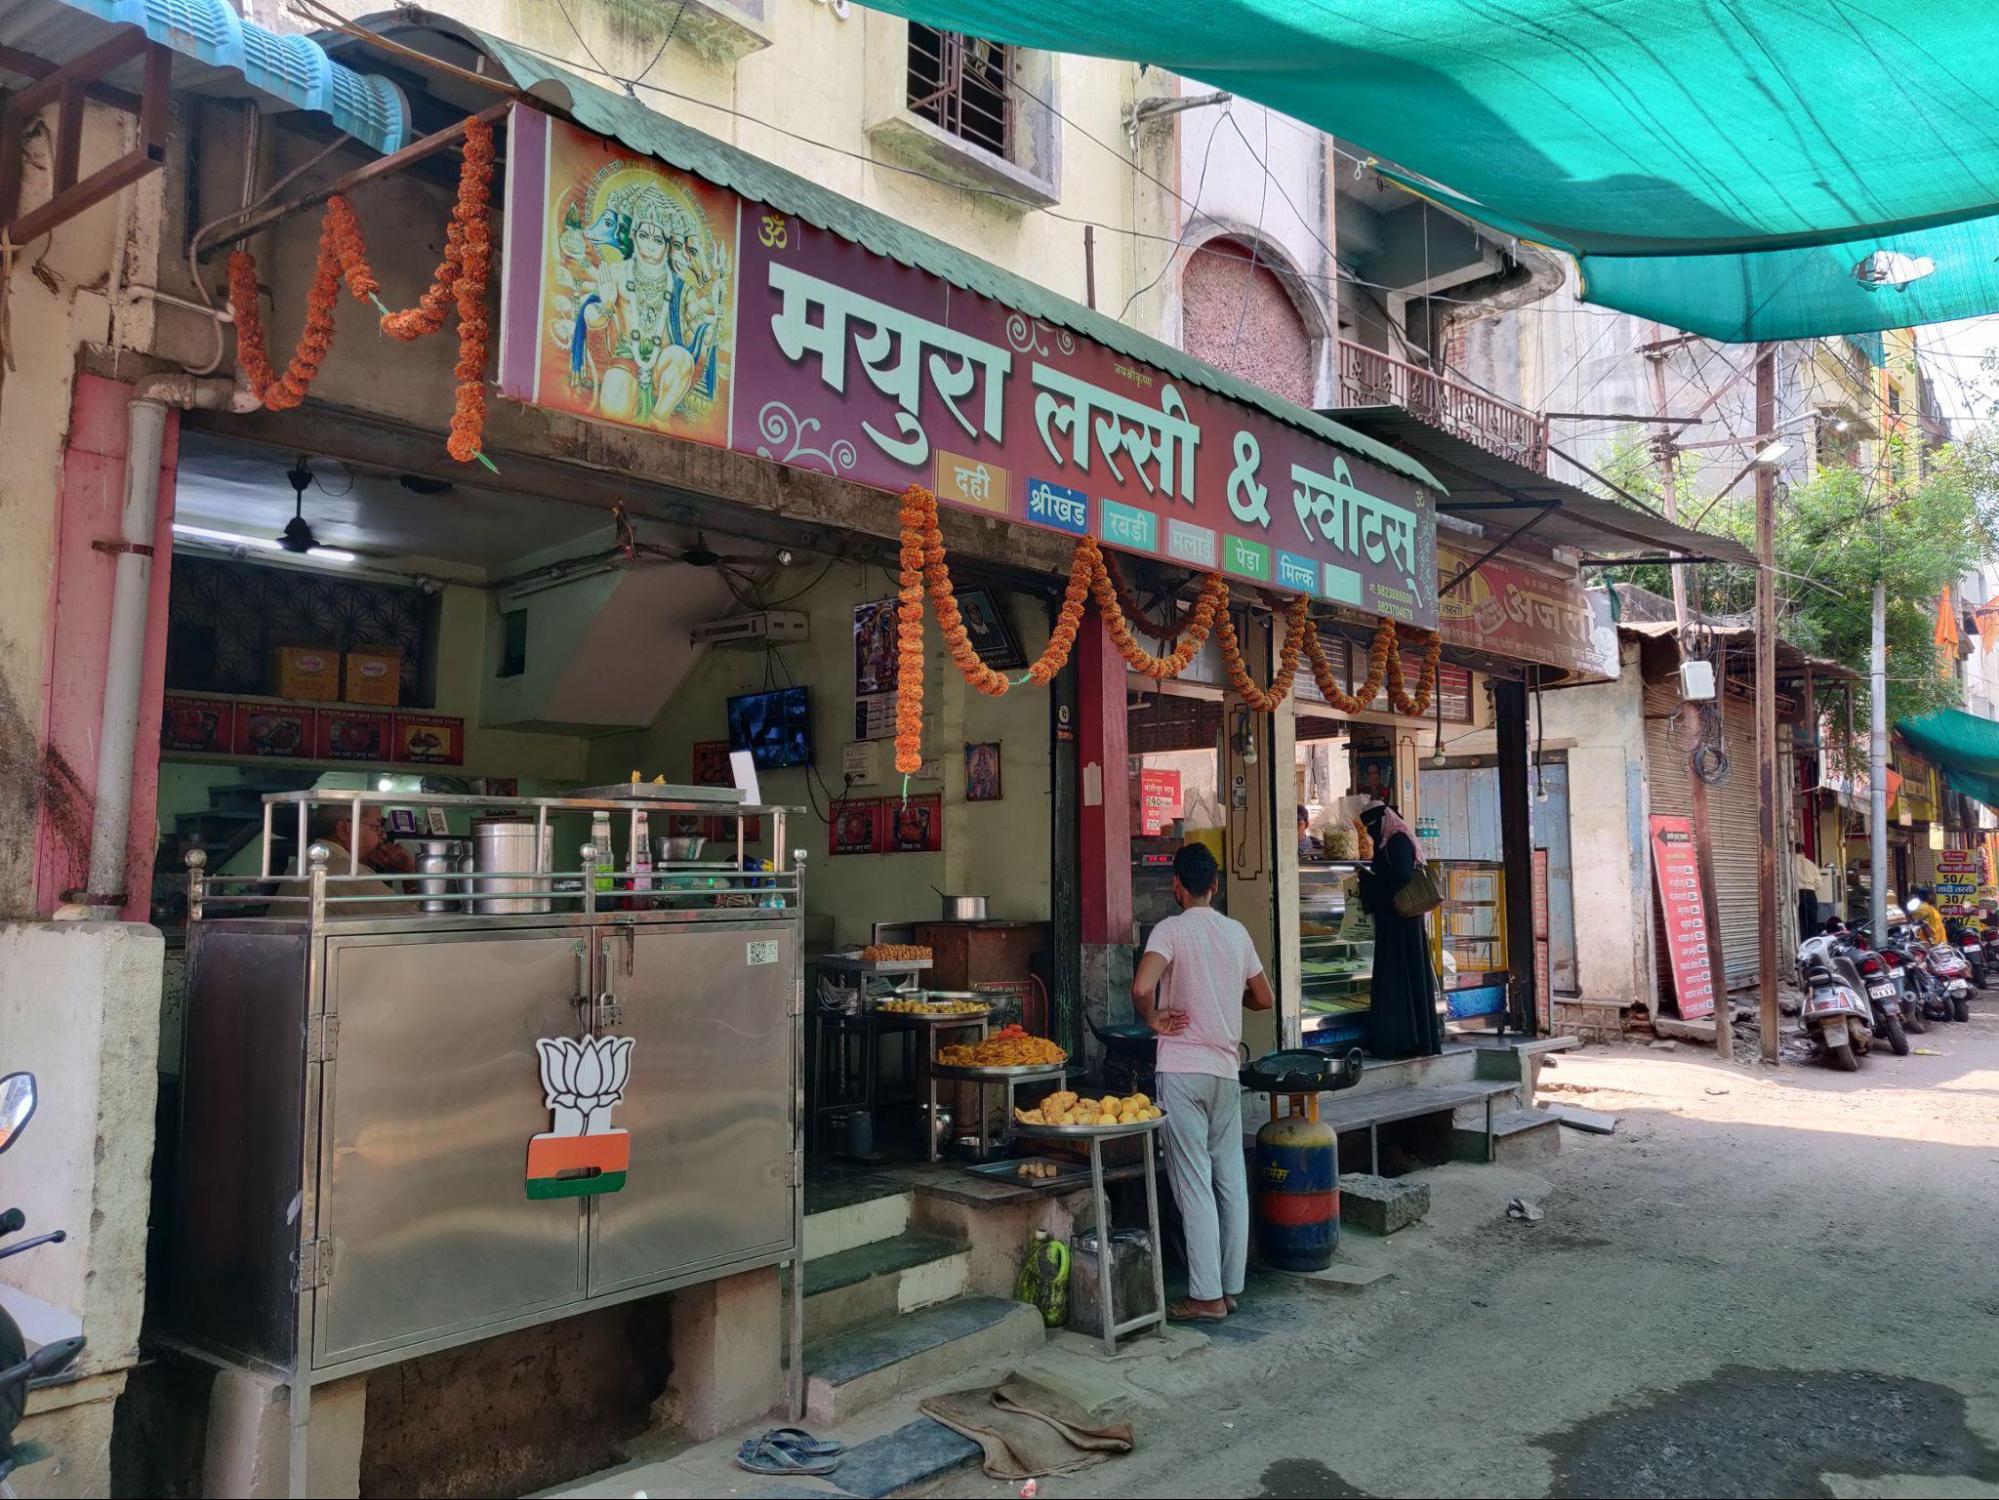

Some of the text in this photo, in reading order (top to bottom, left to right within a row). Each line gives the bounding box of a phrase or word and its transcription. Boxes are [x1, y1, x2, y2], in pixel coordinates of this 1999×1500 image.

[768, 261, 1012, 467] मयुरा
[1032, 361, 1200, 504] लस्सी
[1226, 430, 1273, 529] &
[953, 464, 991, 501] दही
[1030, 484, 1086, 526] श्रीखंड
[1109, 512, 1149, 544] रबडी
[1235, 539, 1261, 572] पेडा
[1280, 554, 1314, 589] मिल्क
